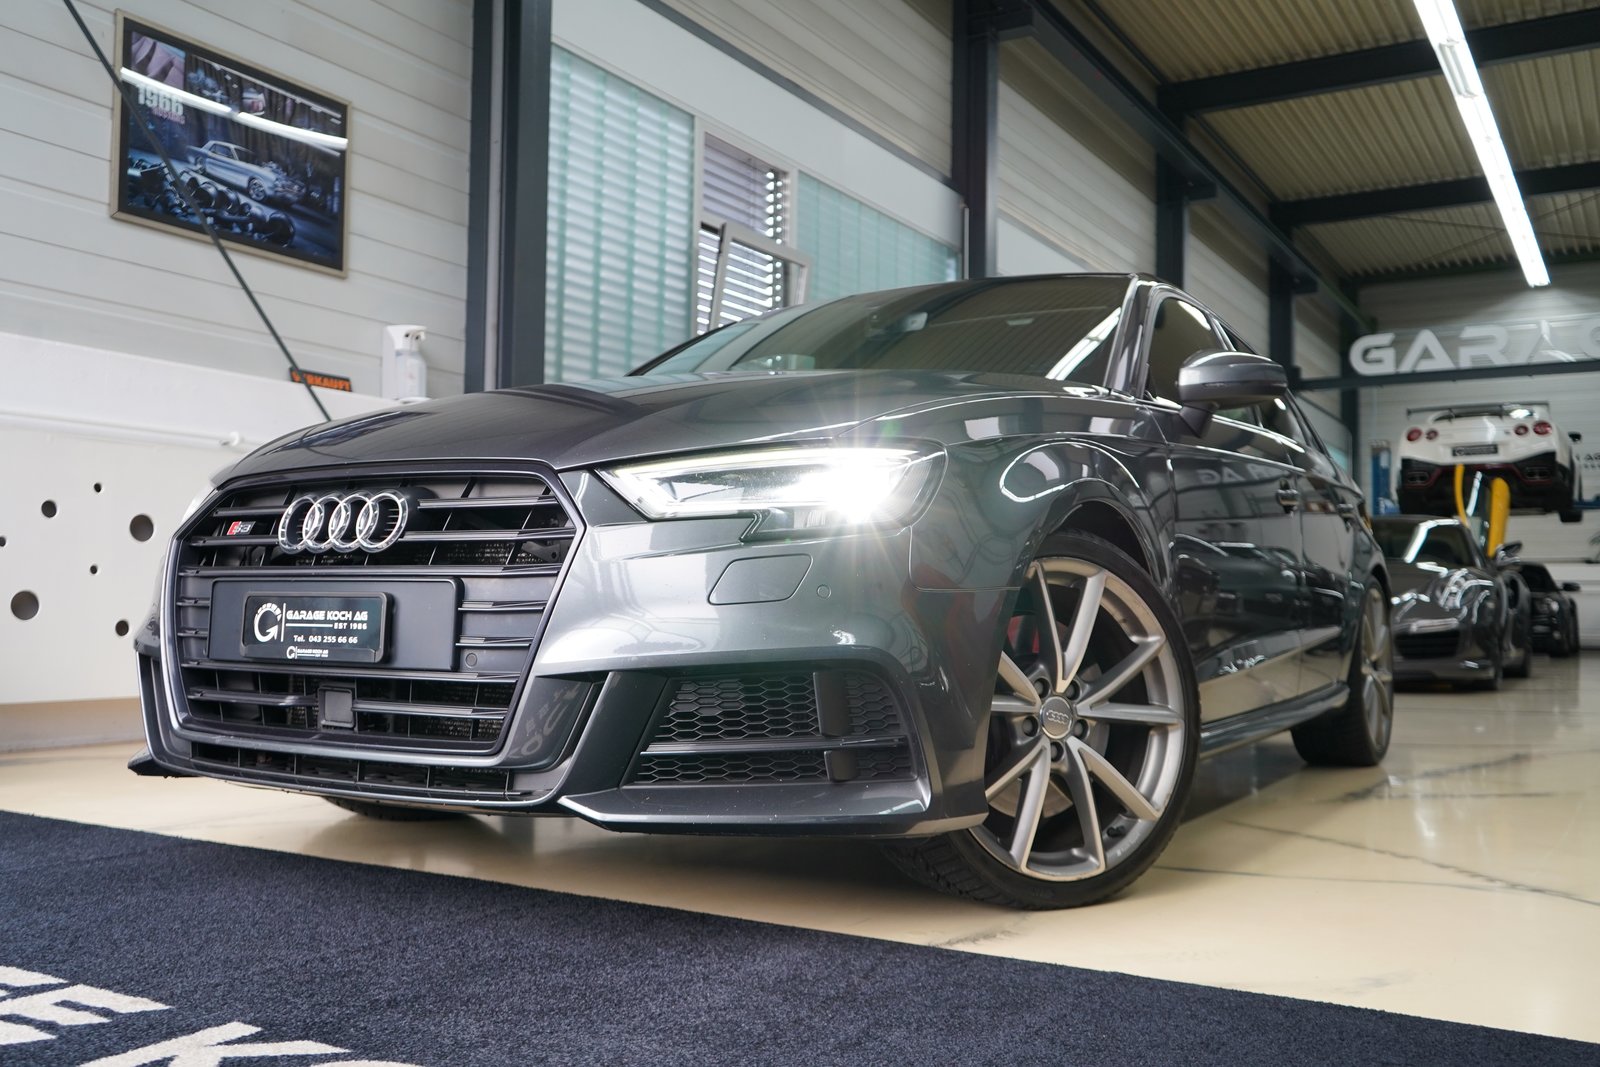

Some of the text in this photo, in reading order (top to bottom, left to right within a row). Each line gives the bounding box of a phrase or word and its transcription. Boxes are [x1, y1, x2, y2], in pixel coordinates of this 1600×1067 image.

[286, 610, 368, 621] GARAGE KOCH AG
[333, 622, 347, 630] EST
[293, 634, 358, 644] Tel. 043 255 66 66
